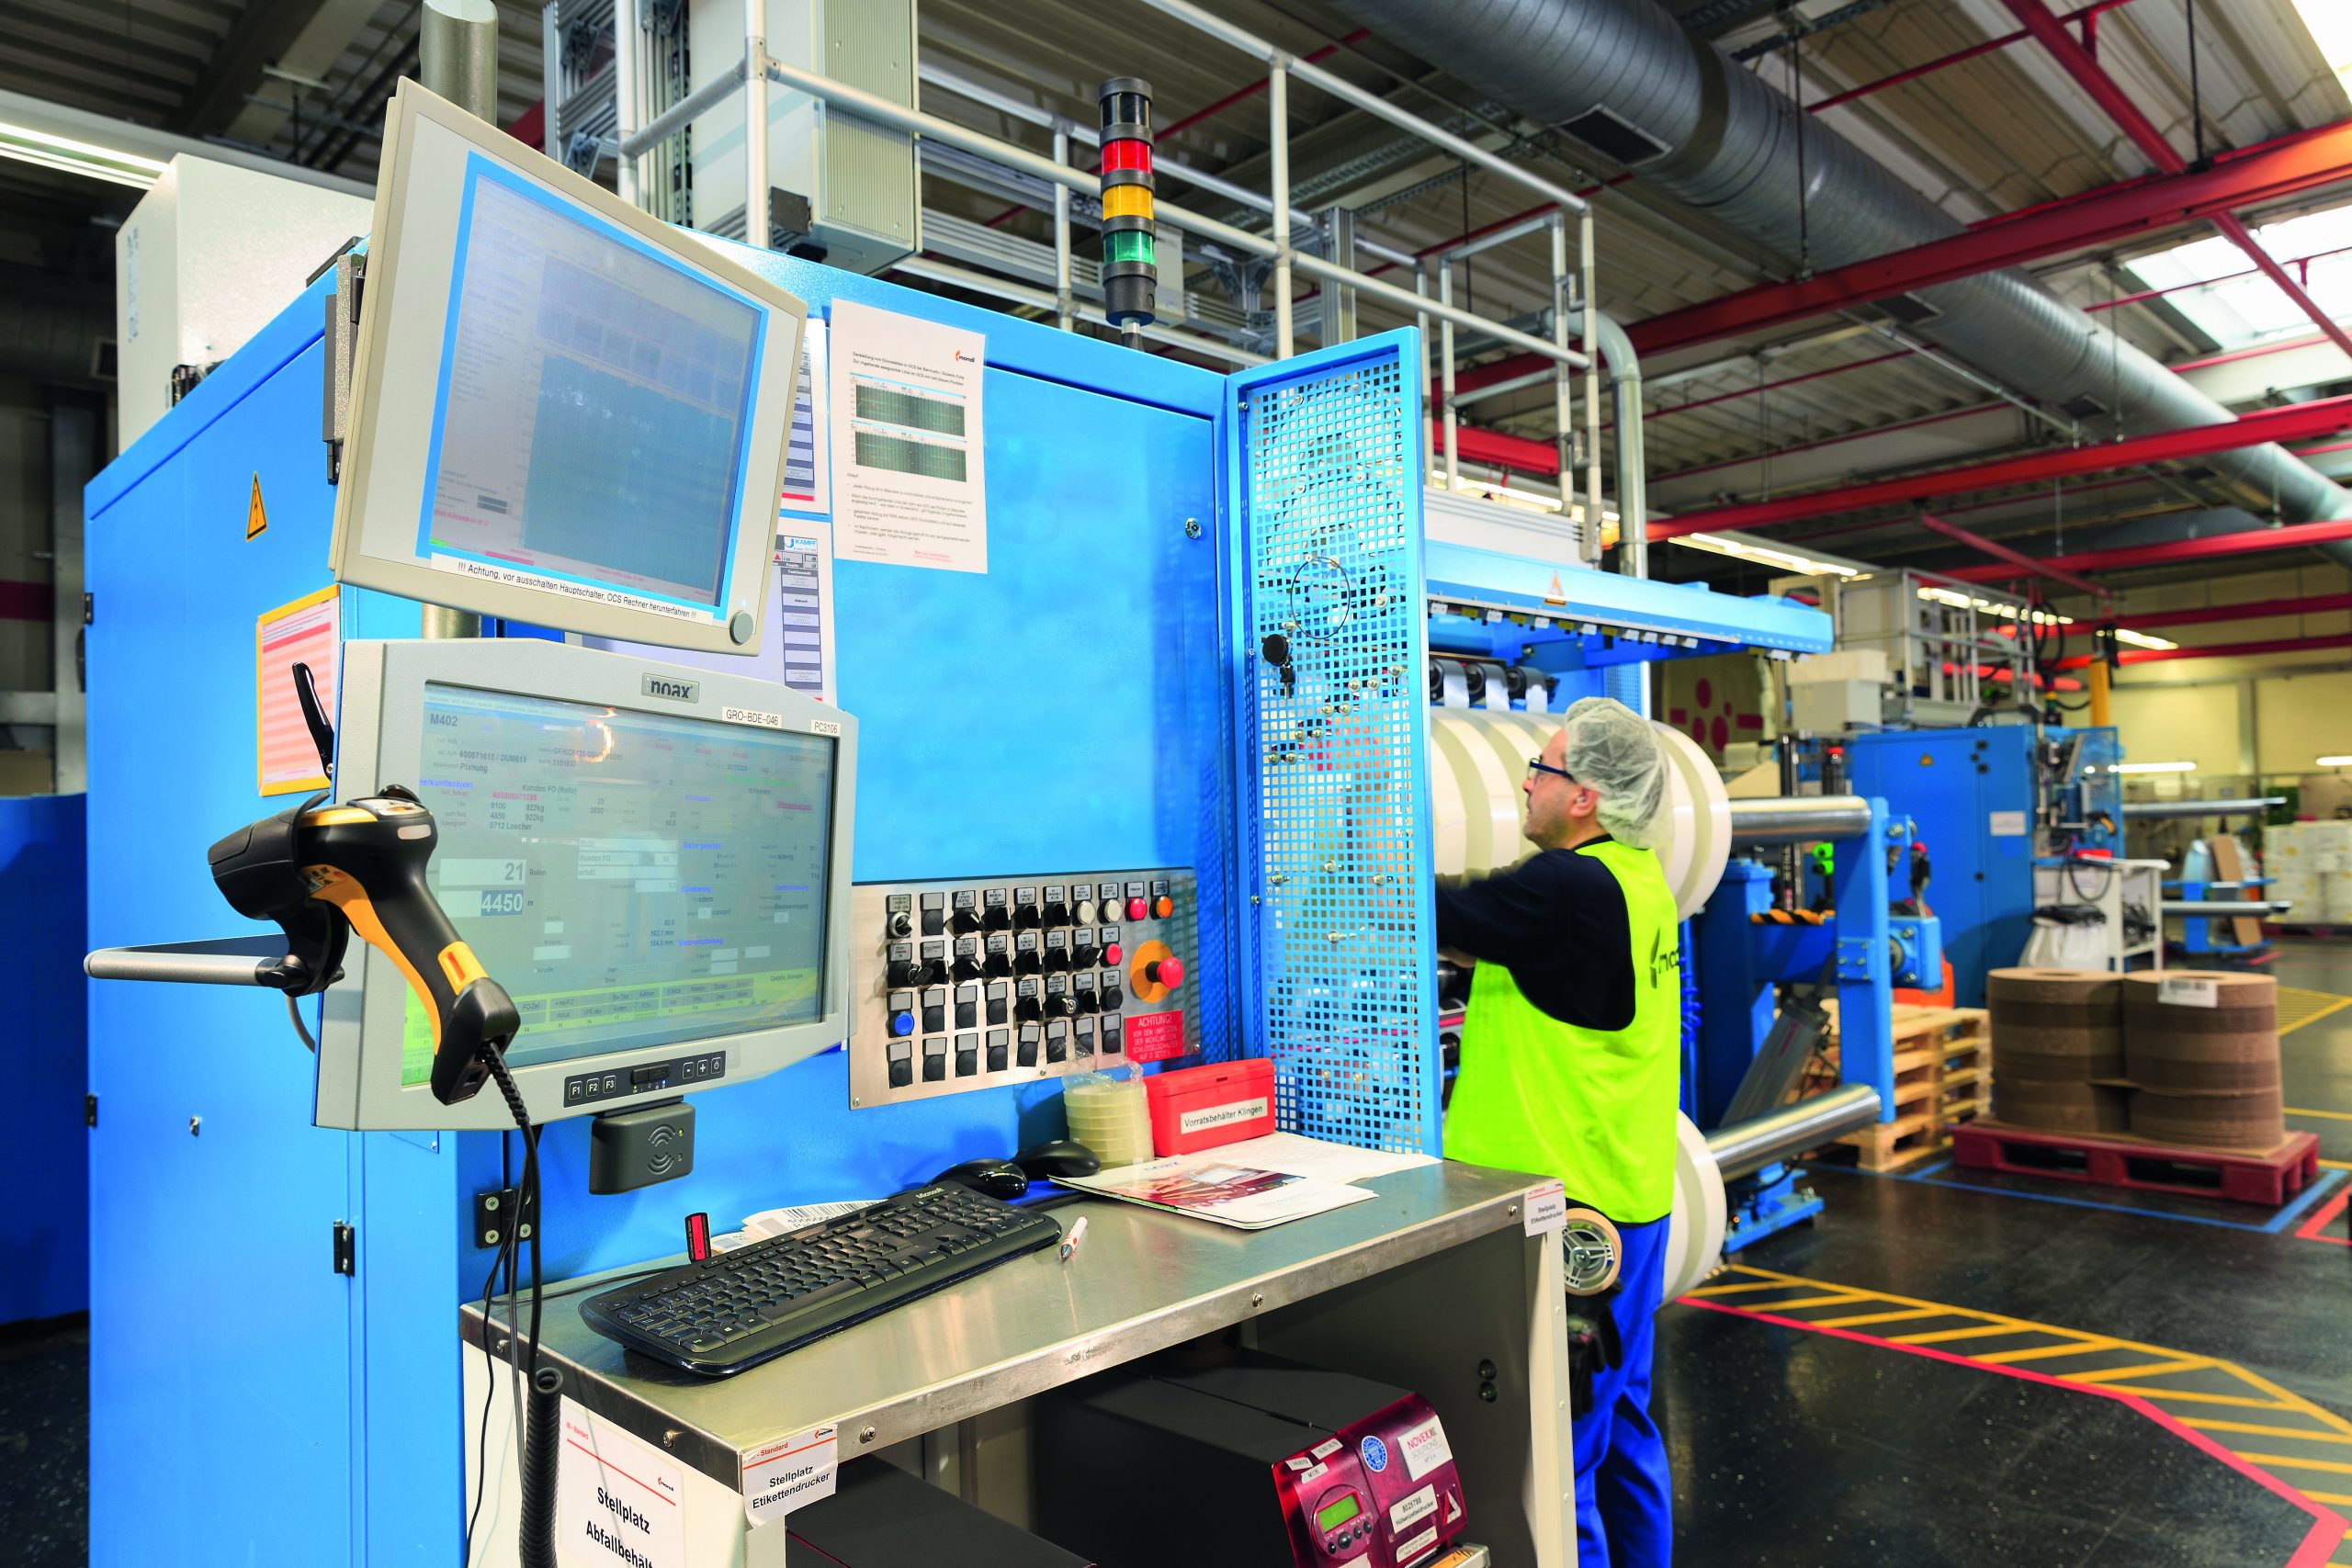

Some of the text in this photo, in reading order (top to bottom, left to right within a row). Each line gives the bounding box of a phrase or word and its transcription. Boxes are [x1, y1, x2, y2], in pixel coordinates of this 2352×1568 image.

[795, 538, 818, 547] KAMPF
[468, 564, 502, 581] Achtung,
[503, 573, 515, 582] vor
[516, 576, 559, 592] ausschalten
[560, 585, 605, 604] Hauptschalter,
[624, 597, 649, 612] Rechner
[650, 603, 690, 617] herunterfahren
[650, 679, 691, 700] noax
[430, 713, 458, 728] M402
[726, 708, 779, 727] GRO-BDE-046
[814, 721, 838, 734] PC3106
[459, 762, 488, 774] Planung
[522, 784, 546, 794] Kunden
[579, 853, 601, 863] Kunden
[503, 862, 524, 882] 21
[529, 867, 547, 877] Rollen
[481, 892, 524, 913] 4450
[1137, 1013, 1172, 1029] ACHTUNG!
[571, 1086, 581, 1096] F1
[588, 1083, 597, 1092] F2
[605, 1079, 615, 1089] F3
[1184, 1105, 1263, 1128] Vorratsbehälter Klingen
[915, 1187, 945, 1200] Microsoft
[1407, 1427, 1437, 1450] NOVEXX
[761, 1441, 789, 1456] Standard
[769, 1465, 814, 1489] Stellplatz
[752, 1472, 831, 1510] Etikettendrucker
[597, 1485, 651, 1536] Stellplatz
